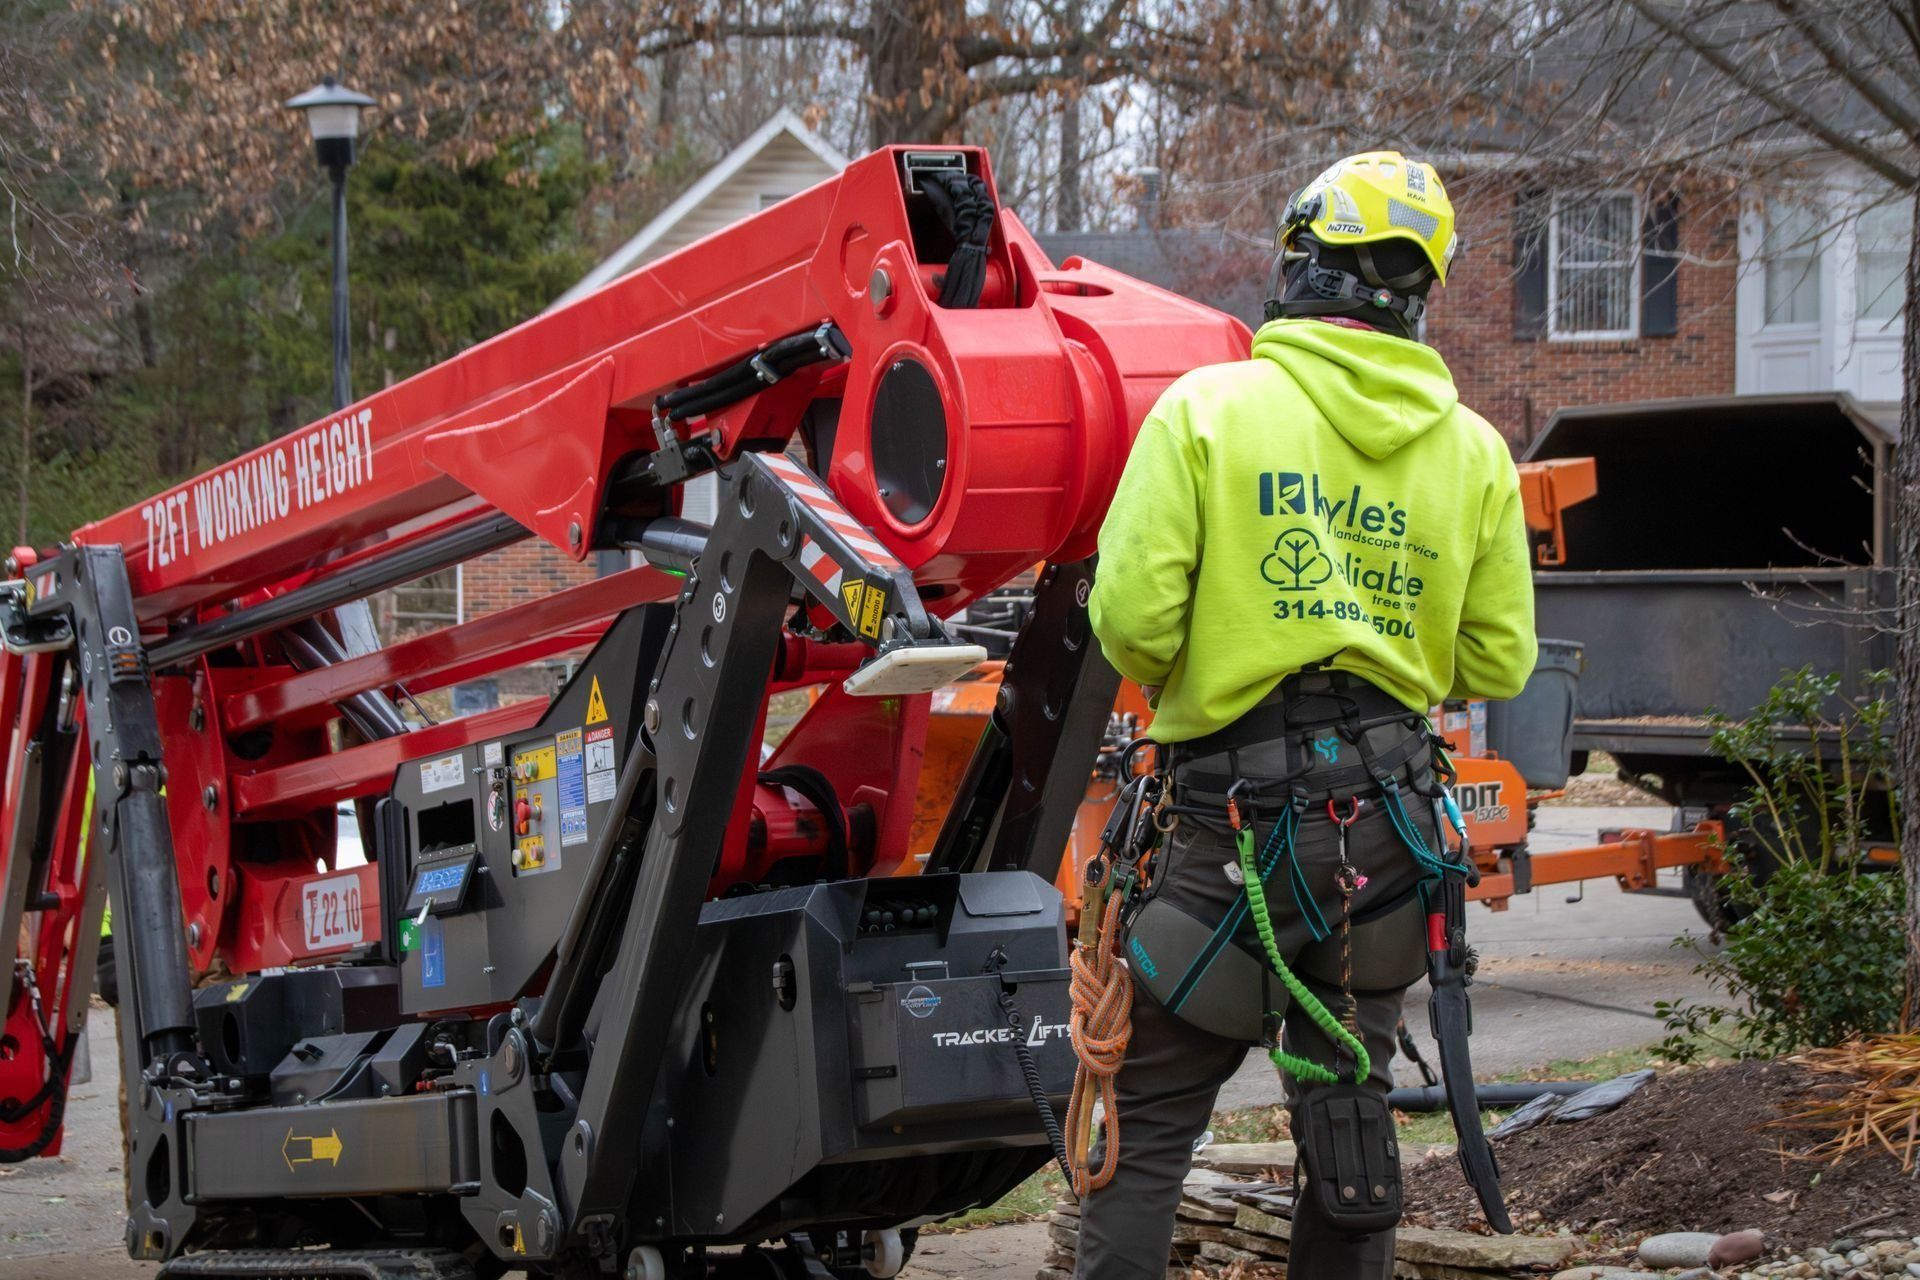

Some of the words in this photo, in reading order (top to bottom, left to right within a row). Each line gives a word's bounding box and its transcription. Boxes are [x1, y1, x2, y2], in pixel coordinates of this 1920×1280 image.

[1326, 223, 1363, 234] NOTCH
[142, 490, 190, 572] 72FT
[193, 447, 290, 549] WORKING
[293, 408, 373, 510] HEIGHT
[1333, 525, 1401, 551] landscape
[871, 599, 881, 625] 20000
[1372, 594, 1401, 610] tree
[591, 728, 612, 742] DANGER
[1130, 935, 1159, 980] NOTCH
[932, 1028, 1023, 1047] TRACKE
